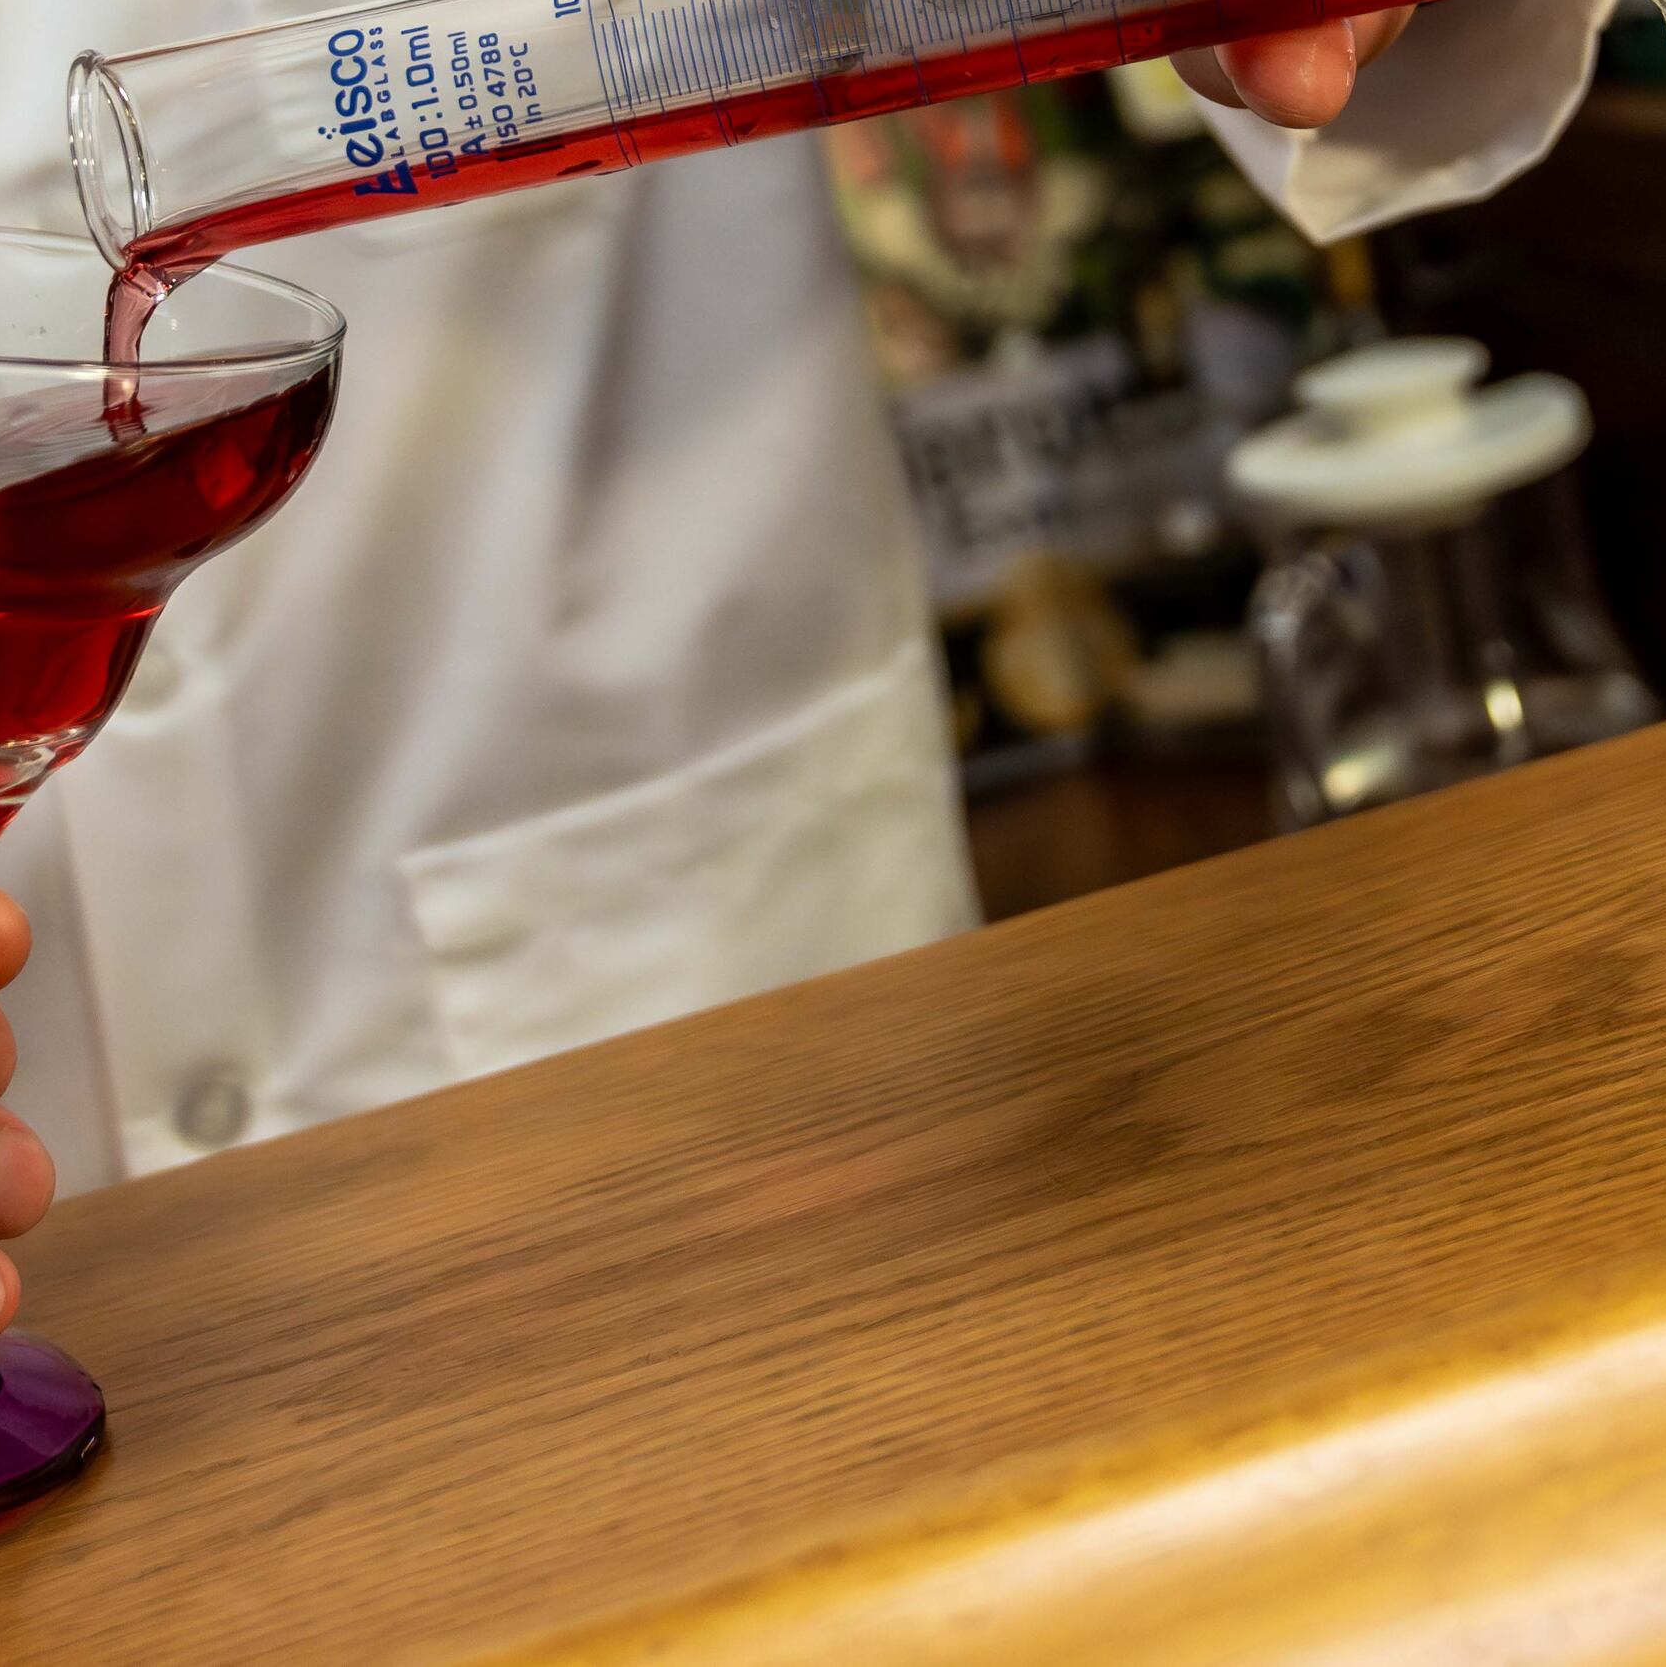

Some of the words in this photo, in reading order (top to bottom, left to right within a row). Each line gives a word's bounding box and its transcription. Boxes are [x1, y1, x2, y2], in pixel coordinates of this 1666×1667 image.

[369, 26, 405, 158] LABGLASS
[479, 32, 506, 98] 4788
[510, 42, 538, 99] 20°C
[492, 104, 520, 145] ISO
